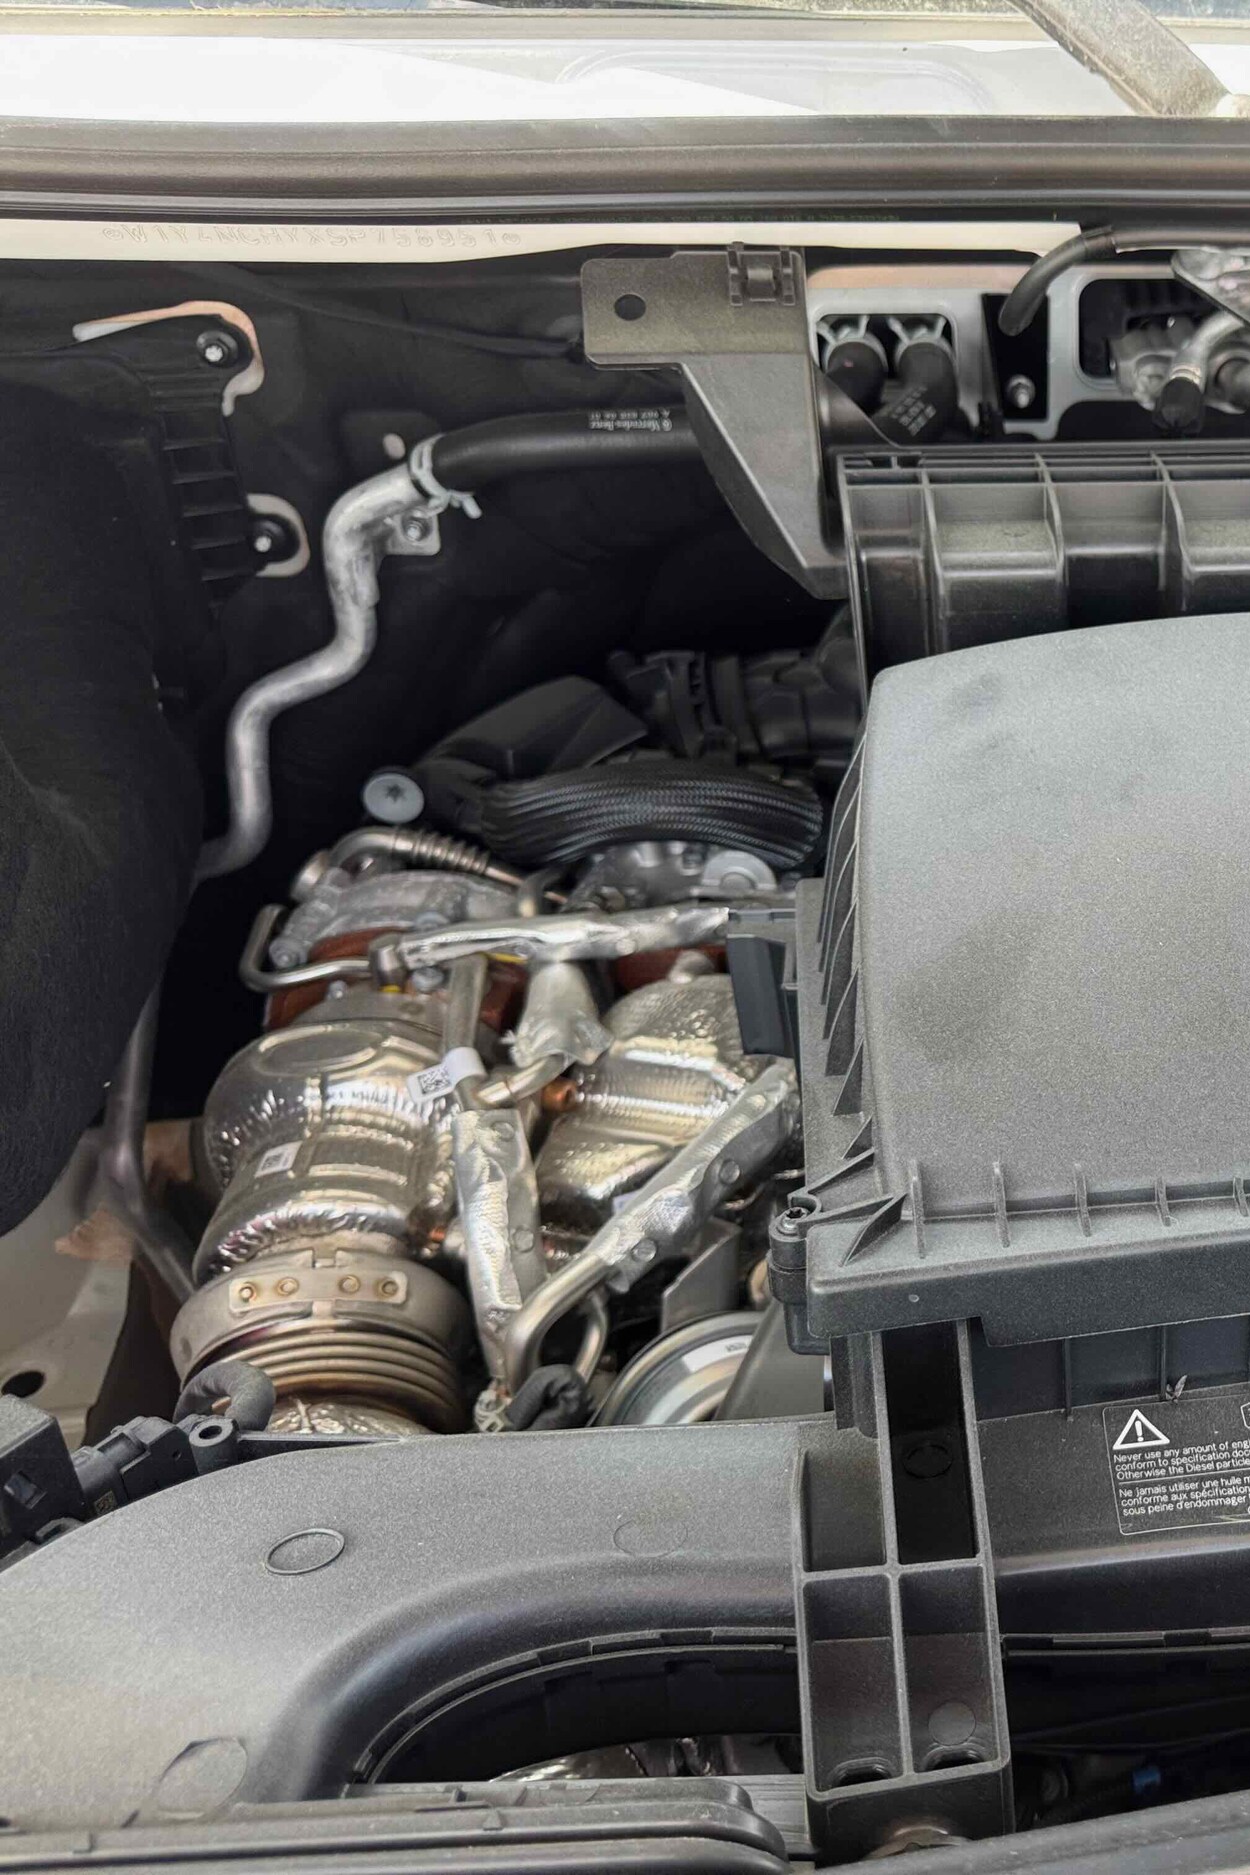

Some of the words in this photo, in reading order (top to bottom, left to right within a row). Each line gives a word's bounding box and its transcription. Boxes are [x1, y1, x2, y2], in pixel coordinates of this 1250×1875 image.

[1113, 1453, 1142, 1463] Never
[1145, 1450, 1161, 1460] use
[1164, 1448, 1180, 1457] any
[1182, 1442, 1217, 1454] amount
[1218, 1441, 1229, 1450] of
[1115, 1460, 1156, 1472] conform
[1158, 1458, 1169, 1467] to
[1171, 1450, 1230, 1466] specification
[1116, 1469, 1167, 1480] Otherwise
[1168, 1465, 1184, 1475] the
[1185, 1461, 1214, 1472] Diesel
[1215, 1456, 1250, 1470] particle
[1118, 1488, 1133, 1498] Ne
[1134, 1484, 1167, 1498] jamais
[1168, 1481, 1200, 1492] utiliser
[1201, 1479, 1219, 1489] une
[1221, 1475, 1242, 1486] huile
[1121, 1493, 1169, 1507] conforme
[1170, 1491, 1188, 1501] aux
[1122, 1506, 1146, 1517] sous
[1147, 1502, 1174, 1515] peine
[1176, 1495, 1247, 1510] d'endommager
